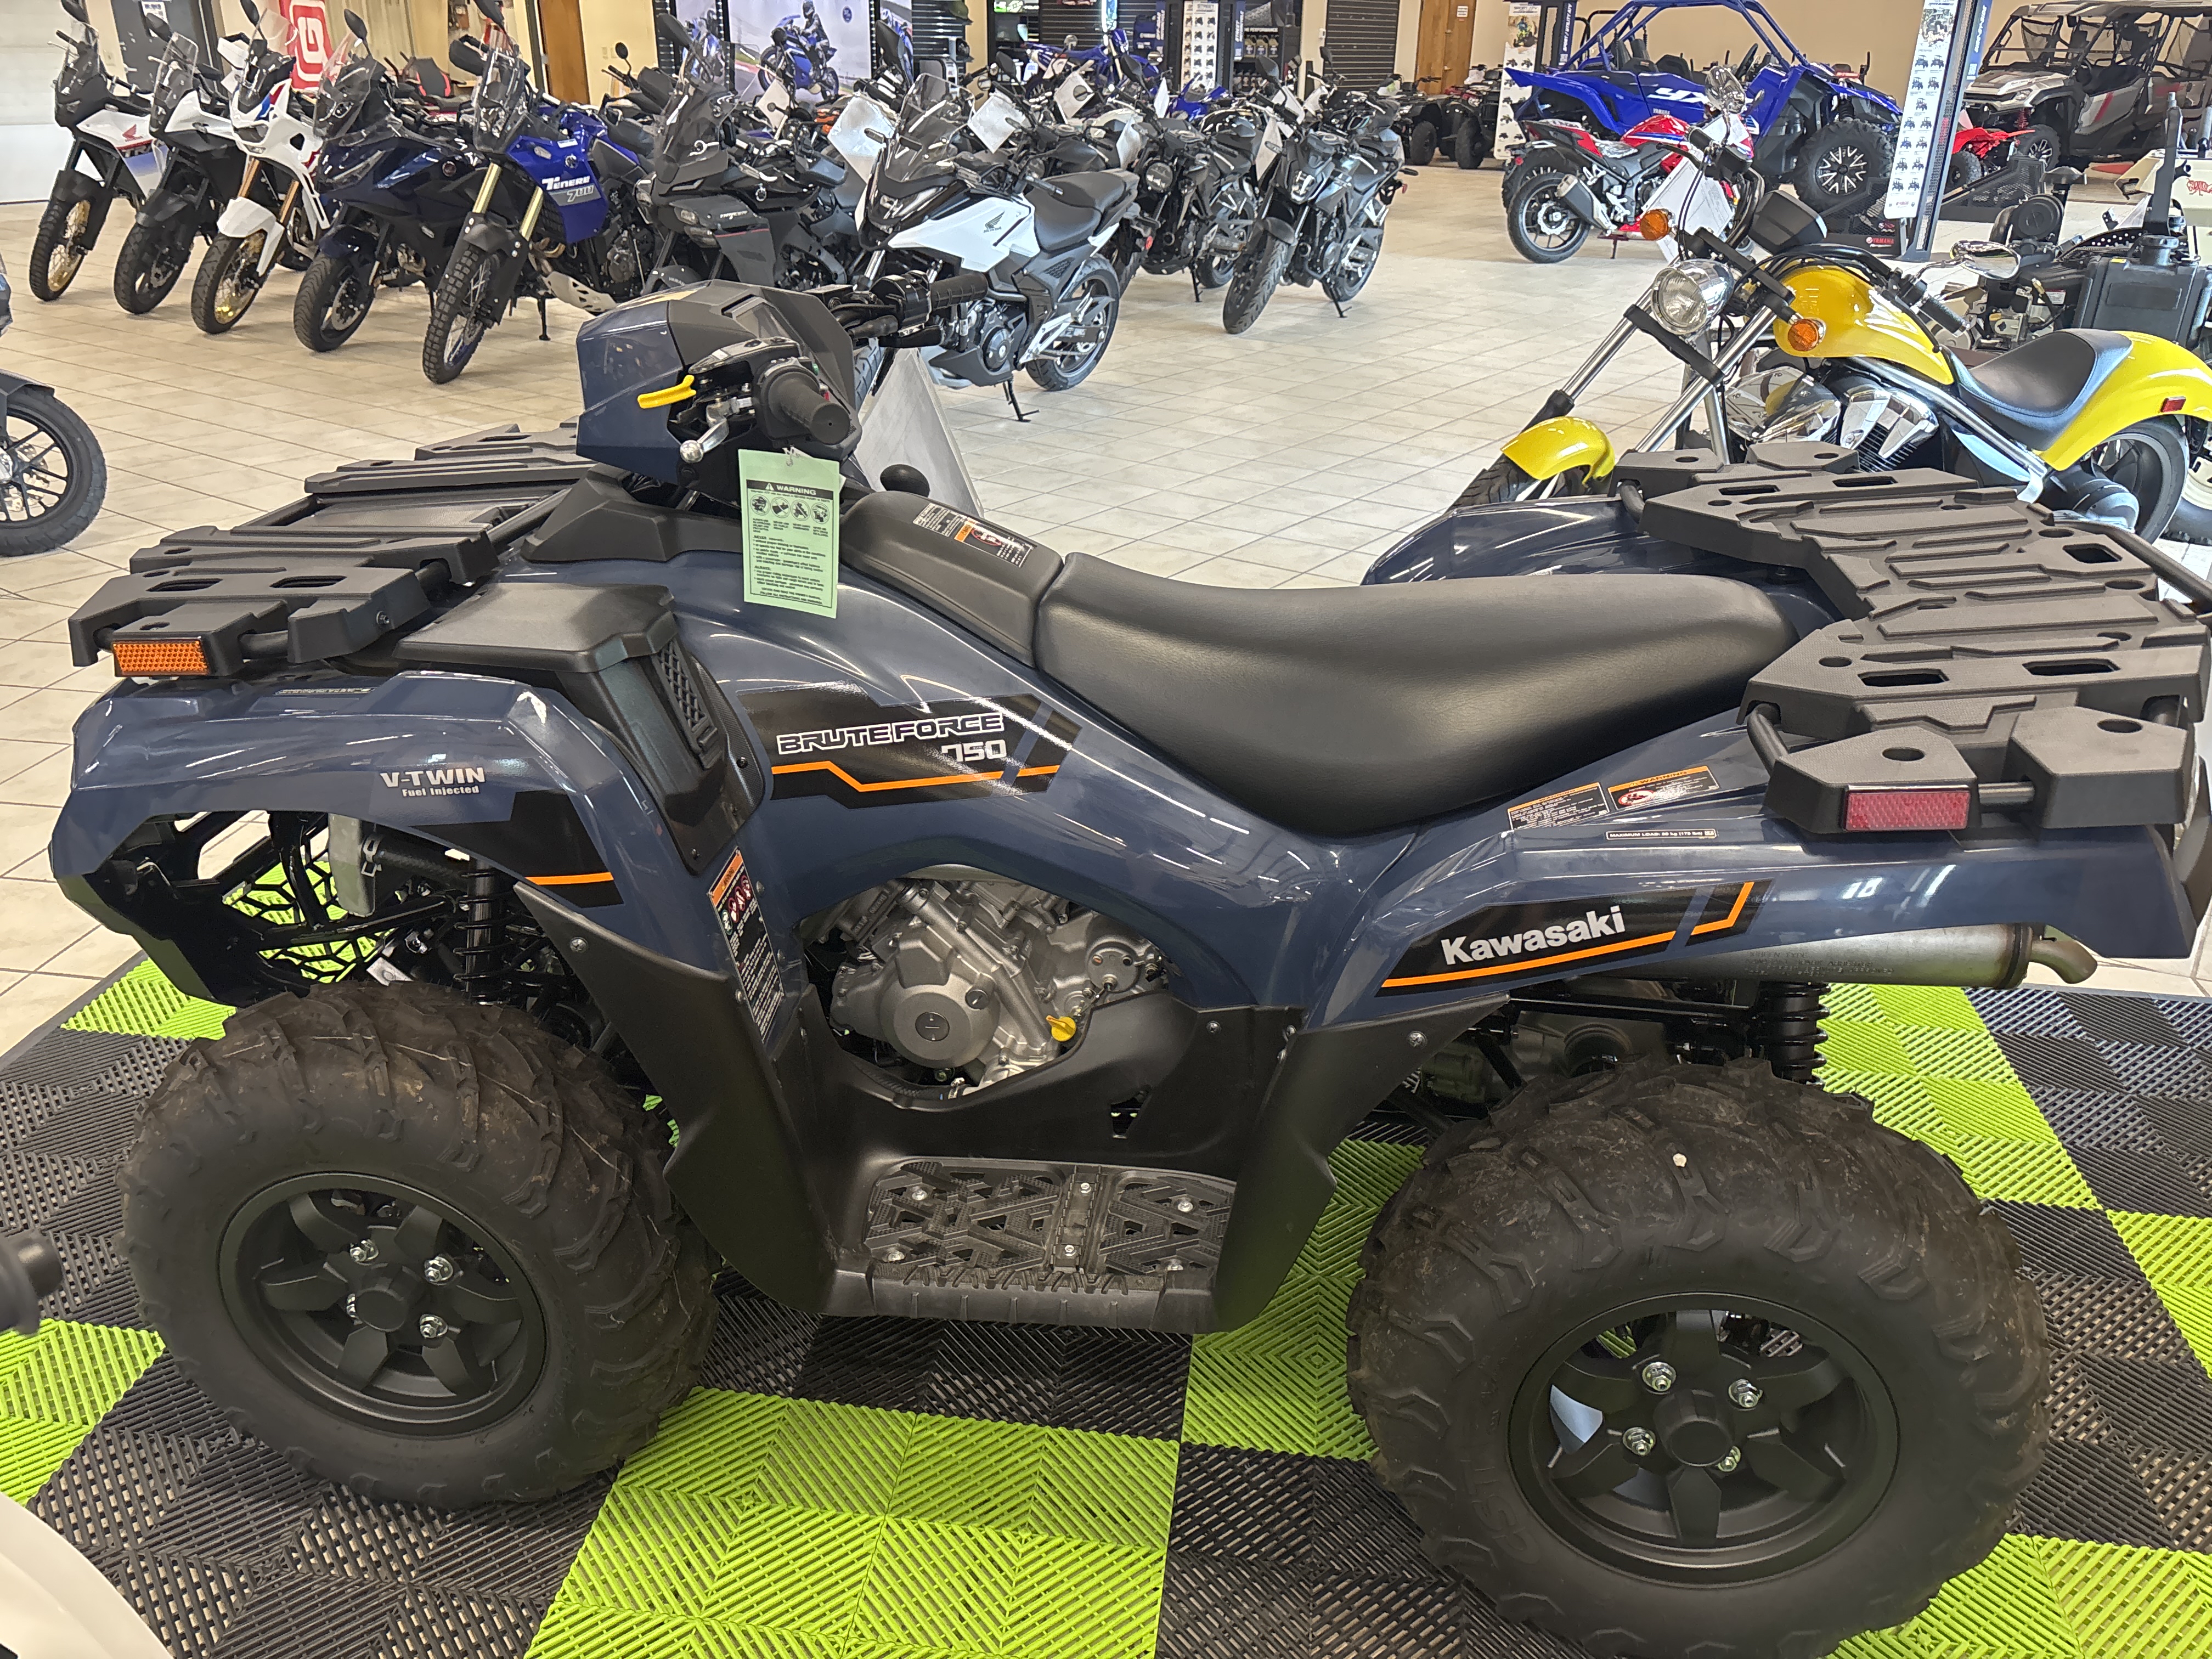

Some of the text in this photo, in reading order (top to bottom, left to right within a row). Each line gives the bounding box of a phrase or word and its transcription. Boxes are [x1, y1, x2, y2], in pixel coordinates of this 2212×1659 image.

[567, 184, 594, 202] 700
[776, 484, 817, 496] WARNING
[777, 713, 1005, 755] BRUTE FORCE
[941, 738, 1007, 763] 750
[380, 767, 486, 788] V-TWIN
[402, 785, 479, 797] Fuel Injected
[1441, 905, 1626, 965] Kawasaki
[1459, 1458, 1543, 1565] CST
